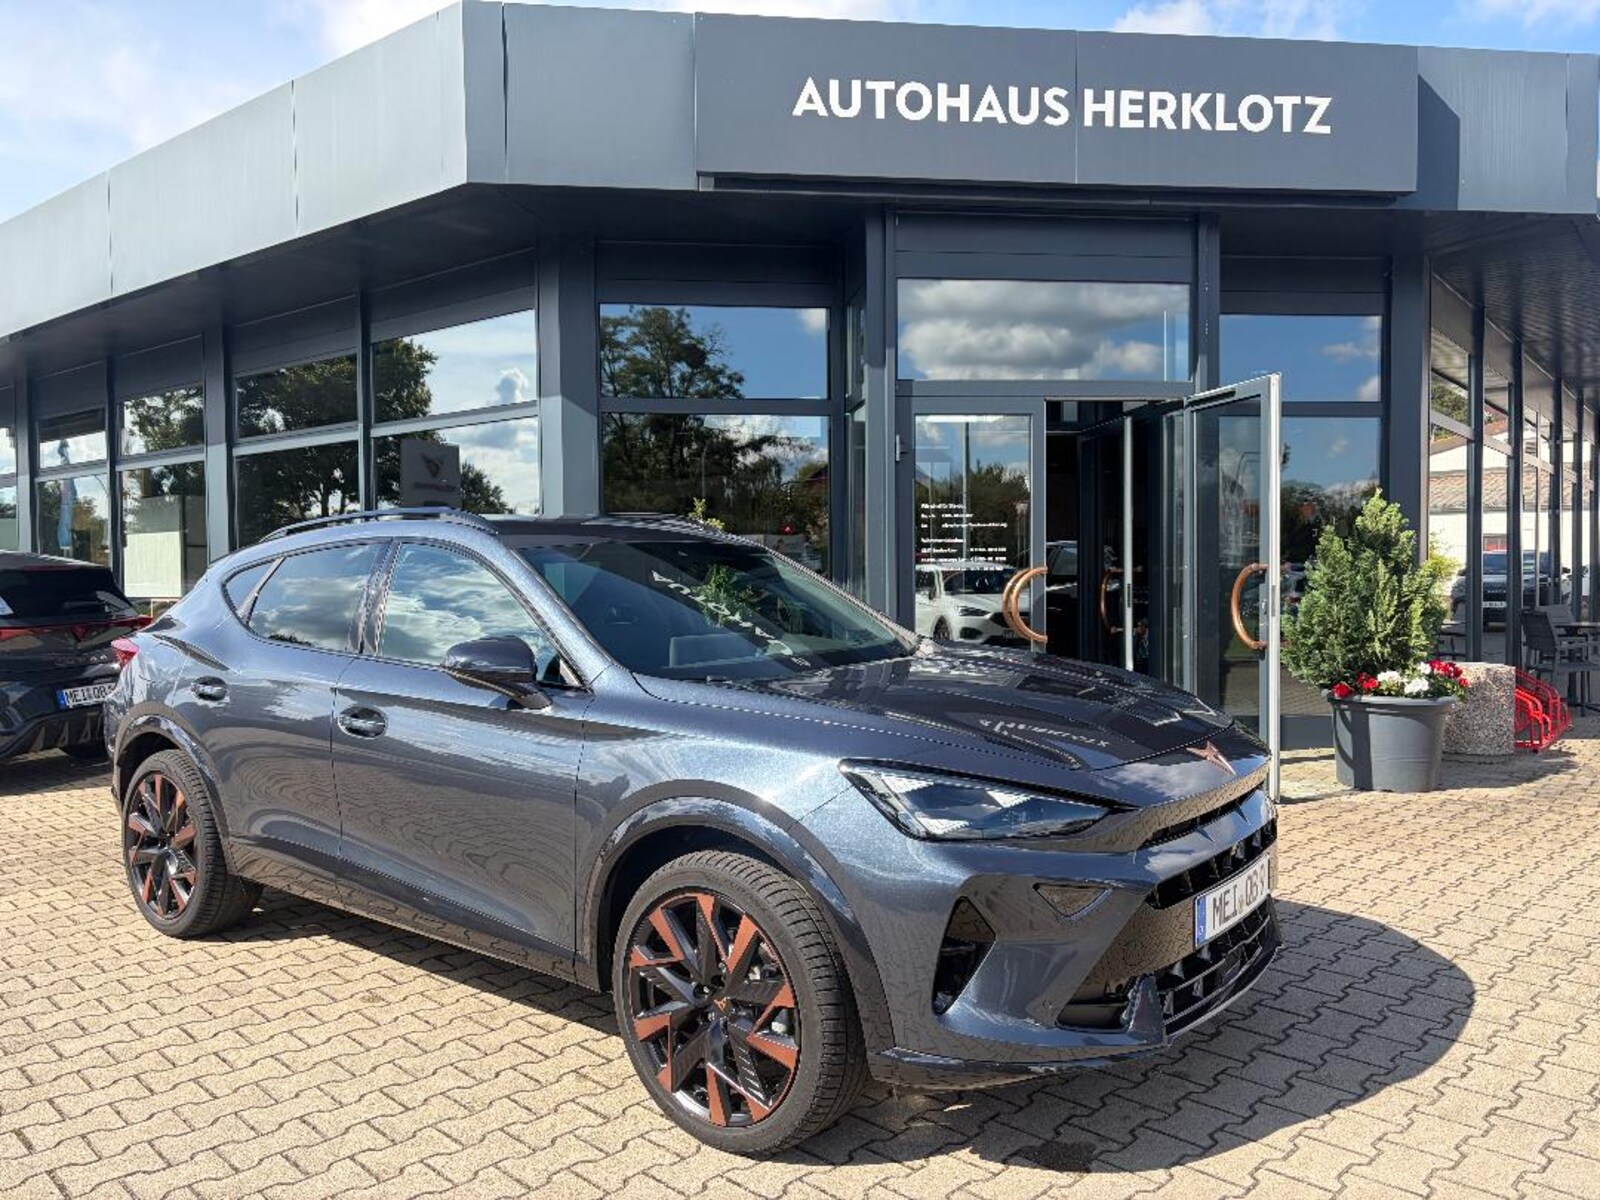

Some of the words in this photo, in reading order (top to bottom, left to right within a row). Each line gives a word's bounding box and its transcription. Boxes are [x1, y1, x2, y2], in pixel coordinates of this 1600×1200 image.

[792, 76, 1070, 127] AUTOHAUS
[1082, 88, 1333, 135] HERKLOTZ
[1213, 884, 1237, 930] MEI
